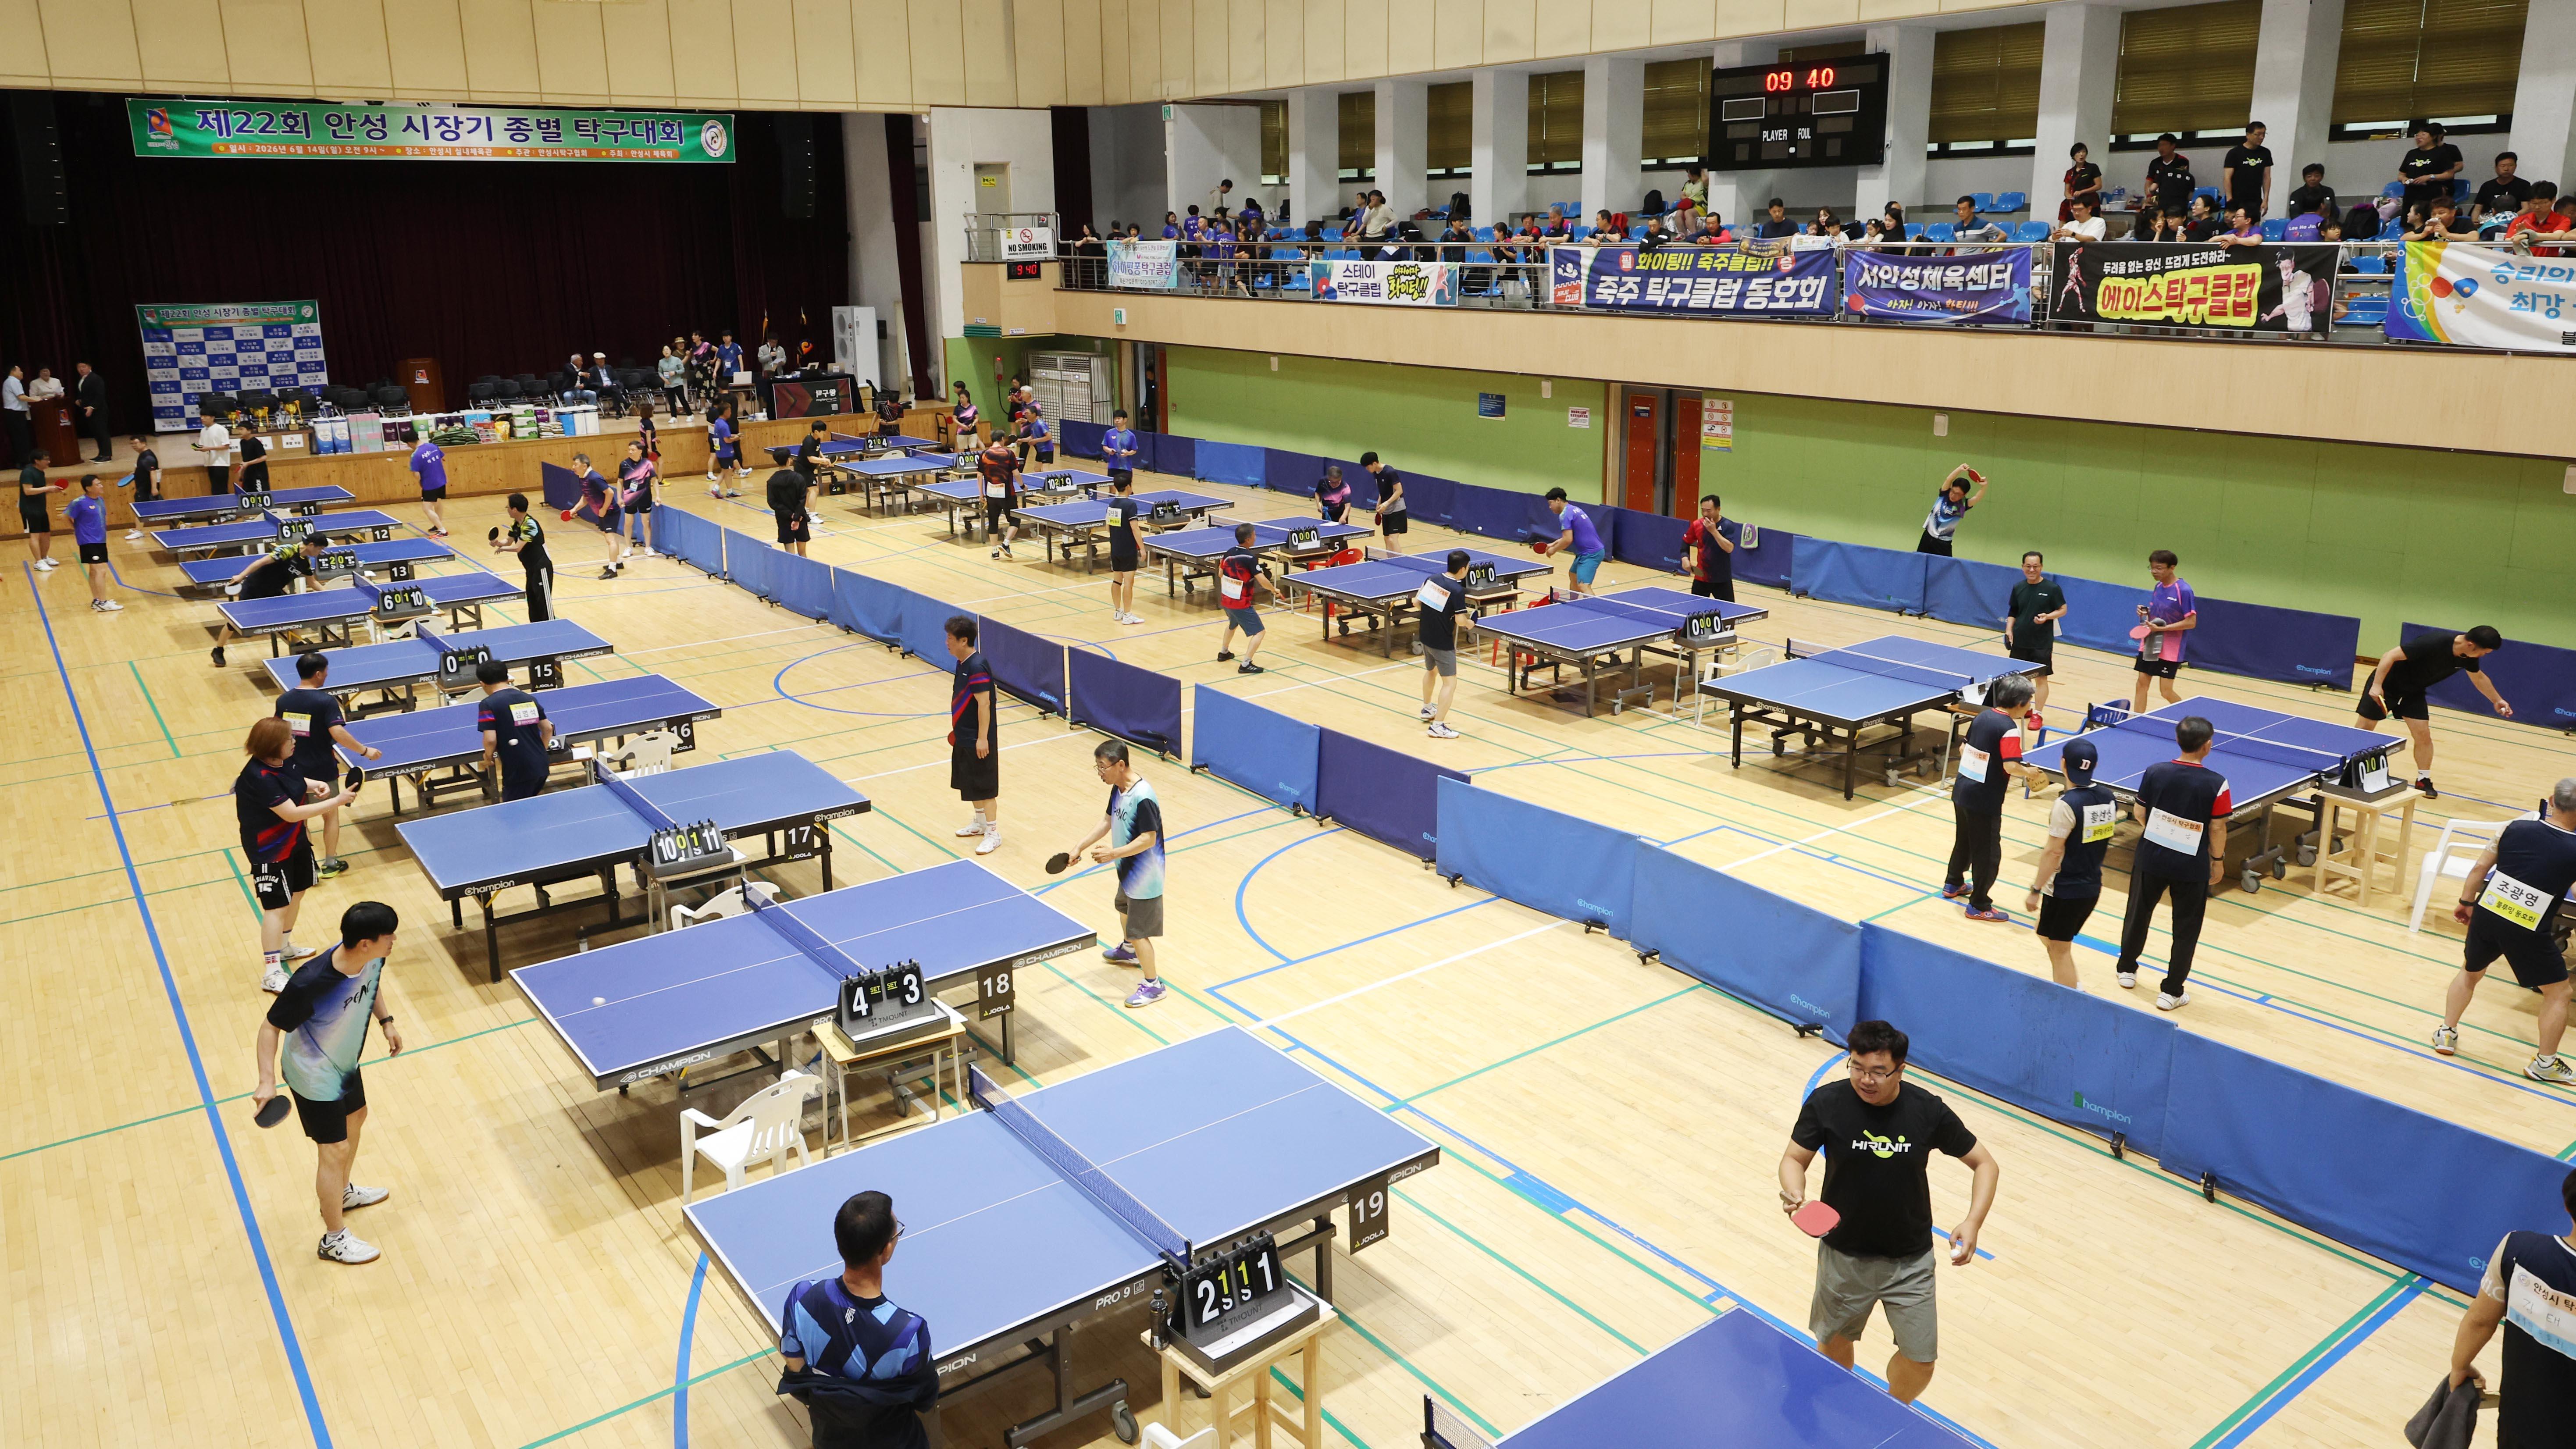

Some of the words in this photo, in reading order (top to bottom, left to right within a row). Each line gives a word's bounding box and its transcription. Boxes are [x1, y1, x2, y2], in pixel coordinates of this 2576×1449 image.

[1766, 71, 1792, 91] 09
[1806, 68, 1834, 88] 40
[196, 109, 312, 139] 제22회
[324, 112, 388, 141] 안성
[402, 114, 494, 143] 시장기
[503, 116, 564, 144] 종별
[573, 117, 684, 146] 탁구대회
[1763, 129, 1788, 142] PLAYER
[1798, 128, 1811, 139] FOUL
[229, 144, 246, 153] 일시
[255, 144, 287, 153] 2026년
[289, 144, 303, 153] 6월
[307, 146, 342, 154] 14일(일)
[345, 146, 361, 154] 오전
[363, 146, 378, 154] 9시
[405, 146, 421, 155] 장소
[454, 147, 493, 156] 실내체육관
[515, 148, 530, 157] 주관
[538, 149, 587, 157] 안성시탁구협회
[1018, 243, 1047, 251] SMOKING
[1017, 265, 1023, 275] 9
[1026, 264, 1037, 274] 40
[1621, 253, 1632, 270] 필
[1635, 253, 1691, 271] 화이팅!!
[1697, 253, 1774, 272] 죽주클럽!!
[2103, 260, 2126, 274] 두려움
[2128, 260, 2143, 273] 없는
[2165, 255, 2190, 269] 뜨겁게
[2191, 251, 2231, 266] 도전하라~
[1342, 264, 1375, 279] 스테이
[1858, 263, 2013, 292] 서안성체육센터
[2490, 261, 2574, 284] 승리의
[1337, 281, 1381, 298] 탁구클럽
[1387, 275, 1429, 301] 화이팅!!
[1595, 275, 1642, 304] 죽주
[1645, 278, 1742, 309] 탁구클럽
[1743, 275, 1828, 310] 동호회
[2101, 271, 2256, 318] 에이스탁구클럽
[1564, 293, 1580, 302] CLUB
[1887, 299, 1914, 310] 아자!
[1917, 301, 1942, 310] 아자!
[2508, 291, 2566, 319] 최강
[242, 497, 249, 508] 0
[264, 495, 271, 507] 0
[303, 506, 315, 515] 11
[282, 525, 291, 538] 6
[304, 523, 314, 535] 10
[374, 529, 388, 539] 12
[1292, 534, 1298, 545] 0
[1305, 531, 1310, 540] 0
[1311, 530, 1317, 542] 0
[1334, 542, 1339, 551] 5
[329, 556, 336, 565] 2
[338, 555, 343, 564] 0
[392, 566, 406, 577] 13
[1470, 570, 1476, 585] 0
[1476, 570, 1481, 579] 0
[1482, 569, 1486, 578] 1
[1488, 567, 1495, 582] 0
[384, 595, 394, 610] 6
[395, 593, 401, 604] 0
[404, 592, 410, 602] 1
[411, 591, 423, 606] 10
[483, 596, 517, 605] CHAMPION
[1382, 595, 1408, 603] CHAMPION
[1692, 619, 1700, 636] 0
[1700, 618, 1705, 629] 0
[1706, 616, 1711, 628] 0
[1714, 616, 1721, 632] 0
[1739, 615, 1762, 623] CHAMPION
[263, 624, 303, 633] CHAMPION
[1507, 635, 1534, 648] CHAMPION
[564, 650, 604, 661] CHAMPION
[1590, 646, 1617, 655] CHAMPION
[446, 655, 457, 673] 0
[534, 663, 553, 678] 15
[2296, 664, 2331, 676] Champion
[1756, 701, 1785, 715] Champion
[385, 763, 437, 777] CHAMPION
[2080, 759, 2091, 770] D
[814, 808, 855, 825] Champion
[2235, 802, 2262, 816] CHAMPION
[788, 826, 810, 845] 17
[658, 836, 677, 861] 10
[676, 834, 687, 849] 0
[690, 831, 699, 847] 1
[702, 827, 721, 851] 11
[259, 883, 273, 893] 15
[464, 880, 515, 896] Champion
[2497, 880, 2539, 907] 조광영
[1577, 898, 1614, 918] Champion
[2496, 901, 2515, 916] 블루밍
[2515, 910, 2536, 923] 동호회
[1026, 943, 1082, 965] CHAMPION
[983, 972, 1010, 998] 18
[852, 986, 868, 1017] 4
[869, 986, 881, 994] SET
[886, 981, 898, 990] SET
[902, 973, 920, 1004] 3
[993, 1004, 1011, 1016] JOOLA
[1790, 993, 1831, 1018] Champion
[812, 1015, 833, 1027] PRO
[879, 1010, 908, 1024] TMOUNT
[638, 1051, 712, 1080] CHAMPION
[2082, 1097, 2131, 1125] hampion
[1851, 1139, 1912, 1154] HIRUNIT
[1354, 1190, 1384, 1224] 19
[1360, 1229, 1386, 1246] JOOLA
[1197, 1279, 1220, 1324] 2
[1217, 1269, 1229, 1295] 1
[1237, 1260, 1249, 1286] 1
[1257, 1251, 1274, 1292] 1
[2533, 1282, 2560, 1306] 안성시
[1095, 1291, 1122, 1311] PRO
[1123, 1286, 1131, 1298] 9
[1229, 1304, 1264, 1325] TMOUNT
